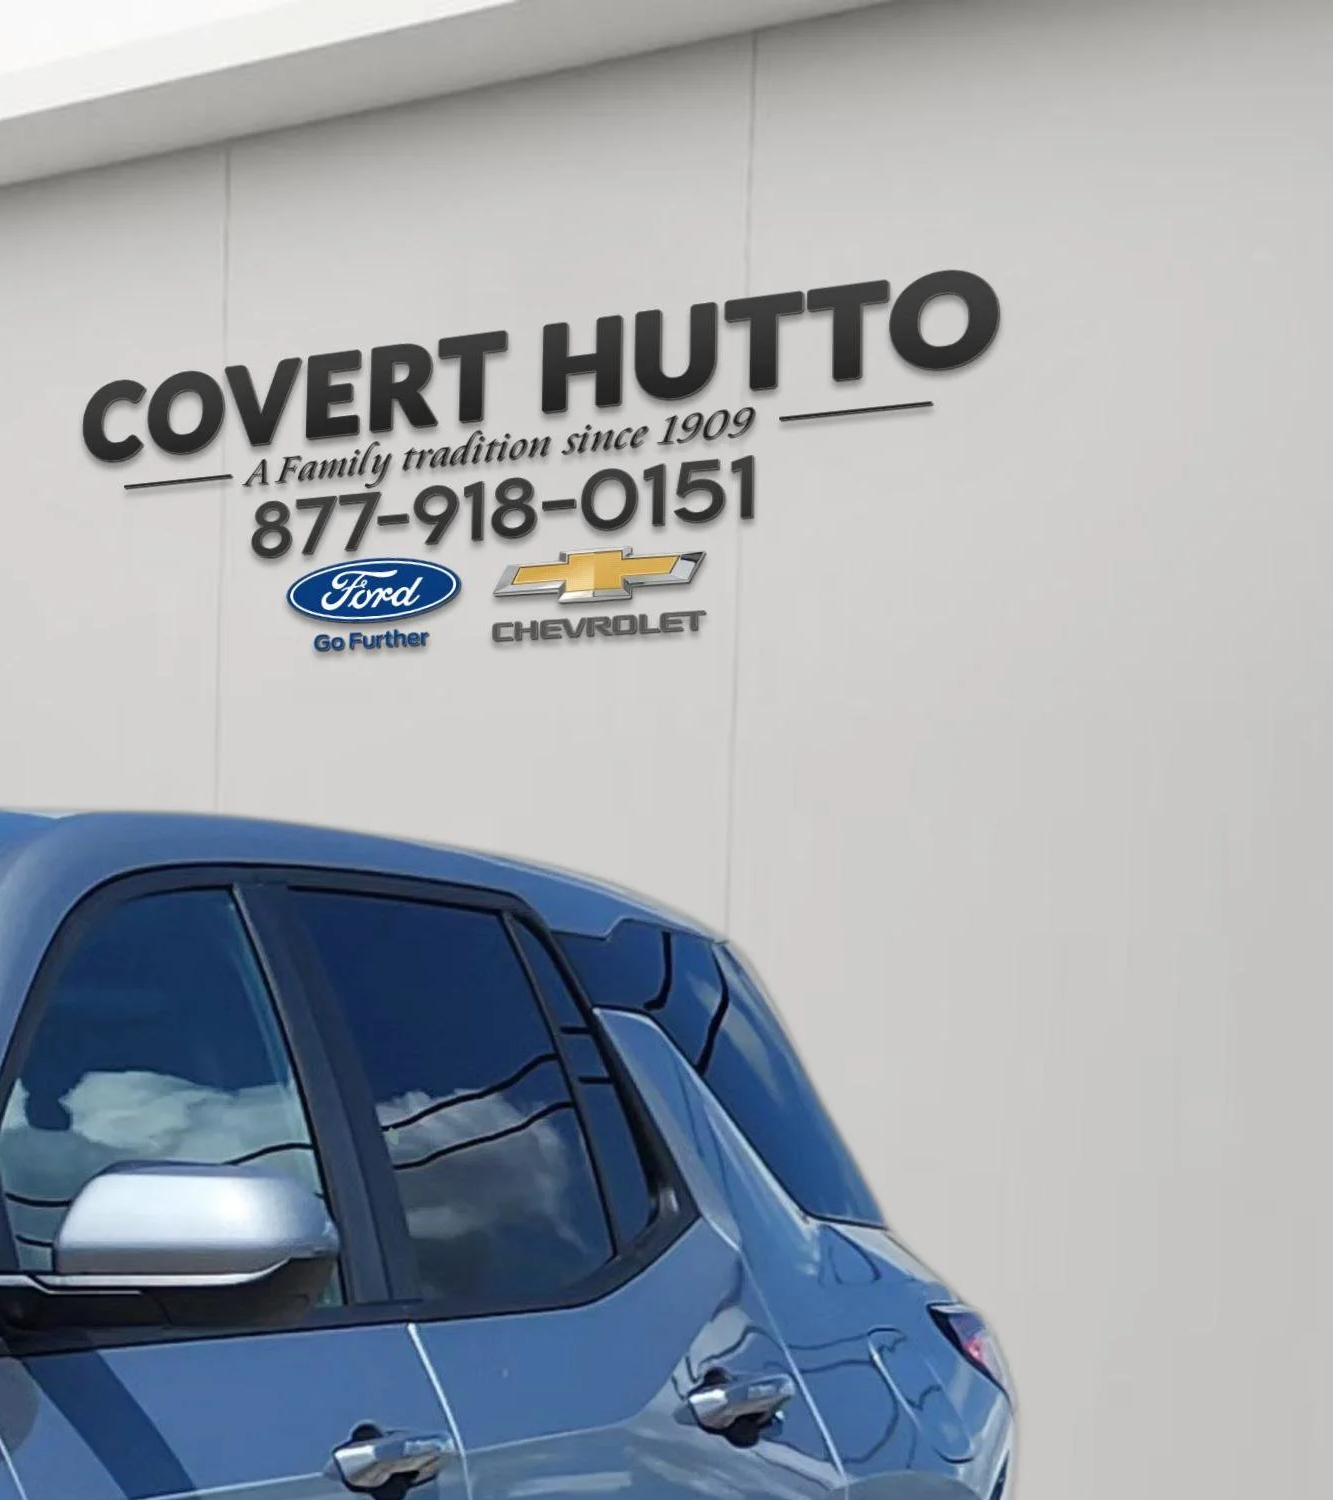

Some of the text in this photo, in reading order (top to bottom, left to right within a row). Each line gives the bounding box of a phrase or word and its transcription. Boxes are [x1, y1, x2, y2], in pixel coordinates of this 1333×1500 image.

[82, 270, 1000, 463] COVERT HUTTO
[243, 407, 756, 488] A Family tradition since 1909
[251, 455, 754, 559] 877-918-0151
[321, 570, 421, 609] Ford
[314, 629, 429, 652] Go Further
[492, 610, 706, 643] CHEVROLET
